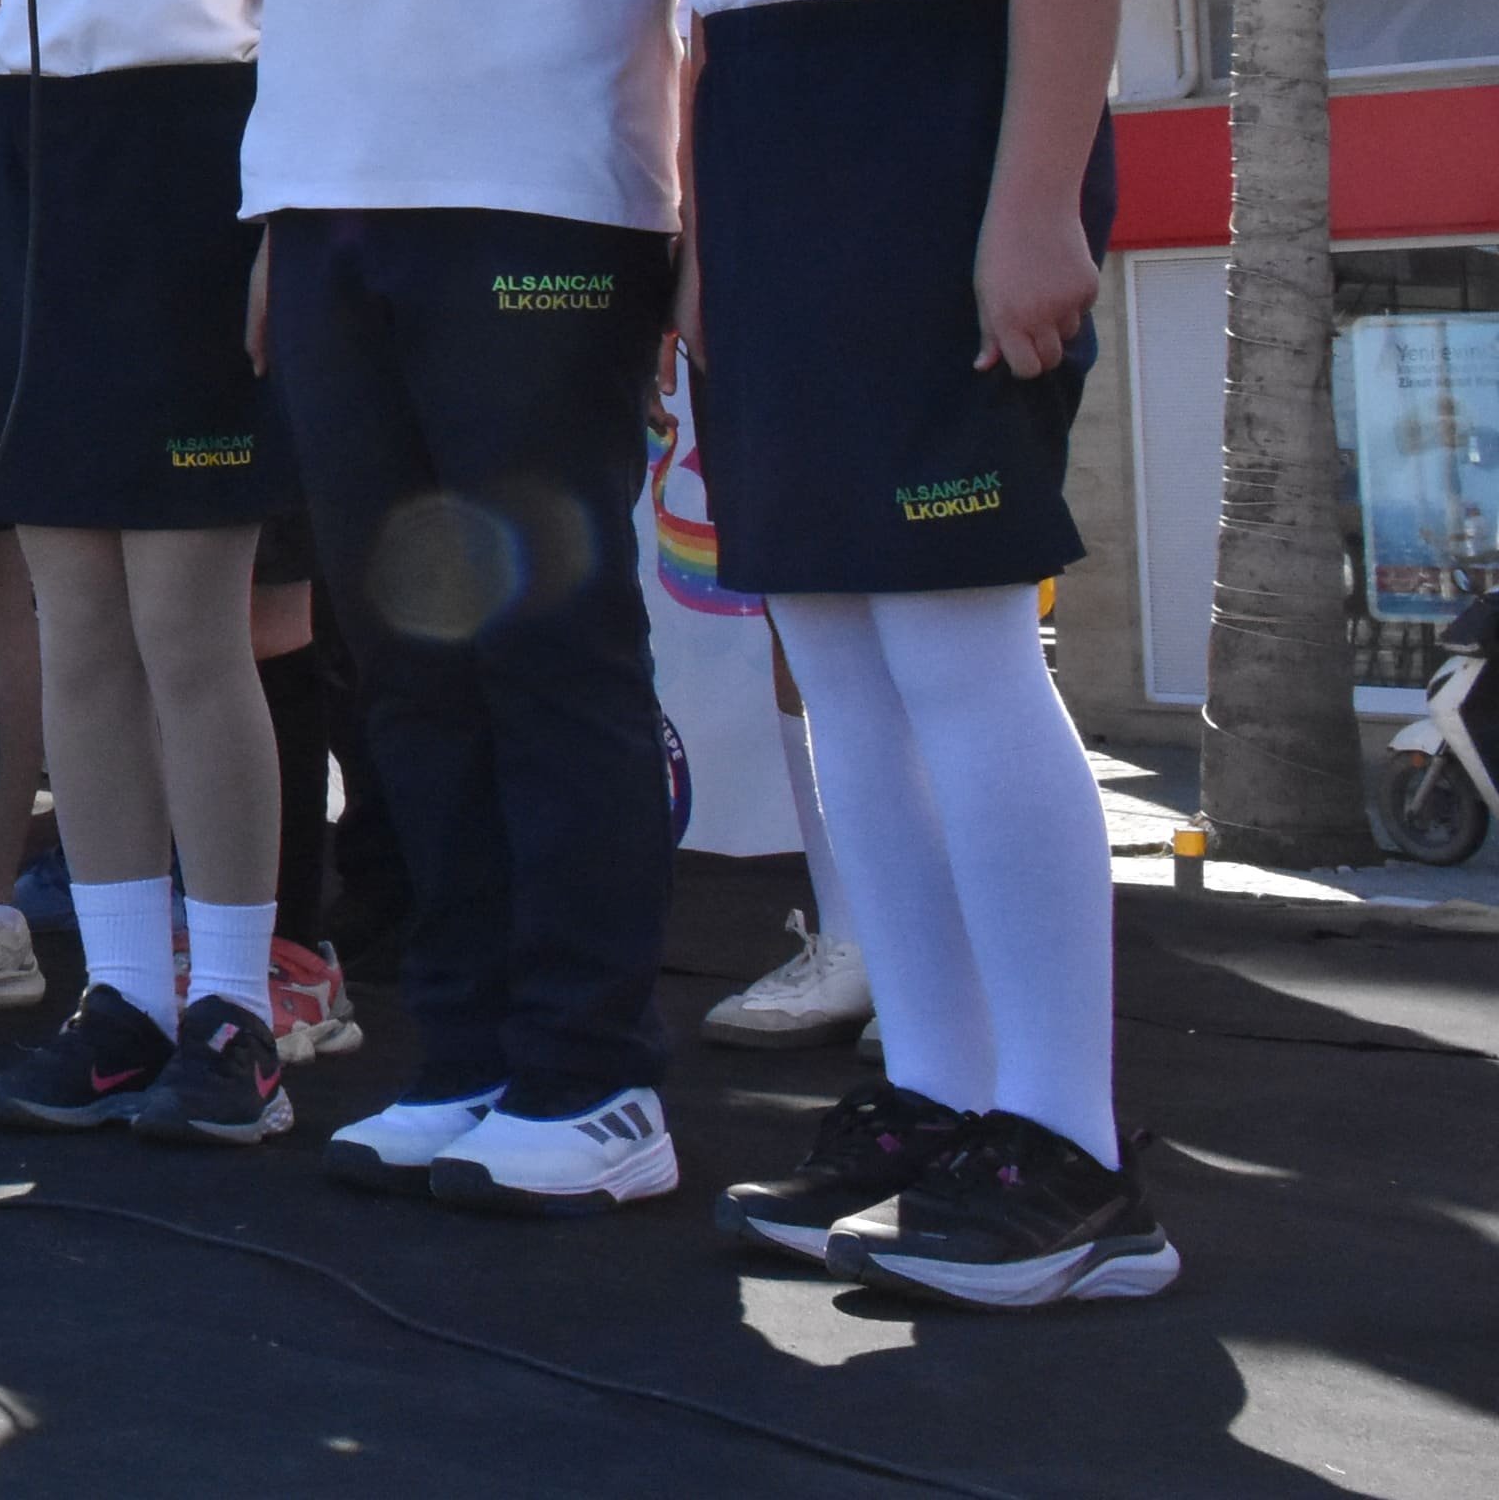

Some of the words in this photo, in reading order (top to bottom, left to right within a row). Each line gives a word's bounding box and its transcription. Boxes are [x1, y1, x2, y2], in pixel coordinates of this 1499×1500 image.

[491, 274, 616, 293] ALSANCAK
[498, 290, 611, 311] İLKOKULU
[166, 434, 255, 453] ALSANCAK
[171, 450, 252, 468] İLKOKULU
[895, 470, 1002, 504] ALSANCAK
[903, 490, 1001, 521] İLKOKULU
